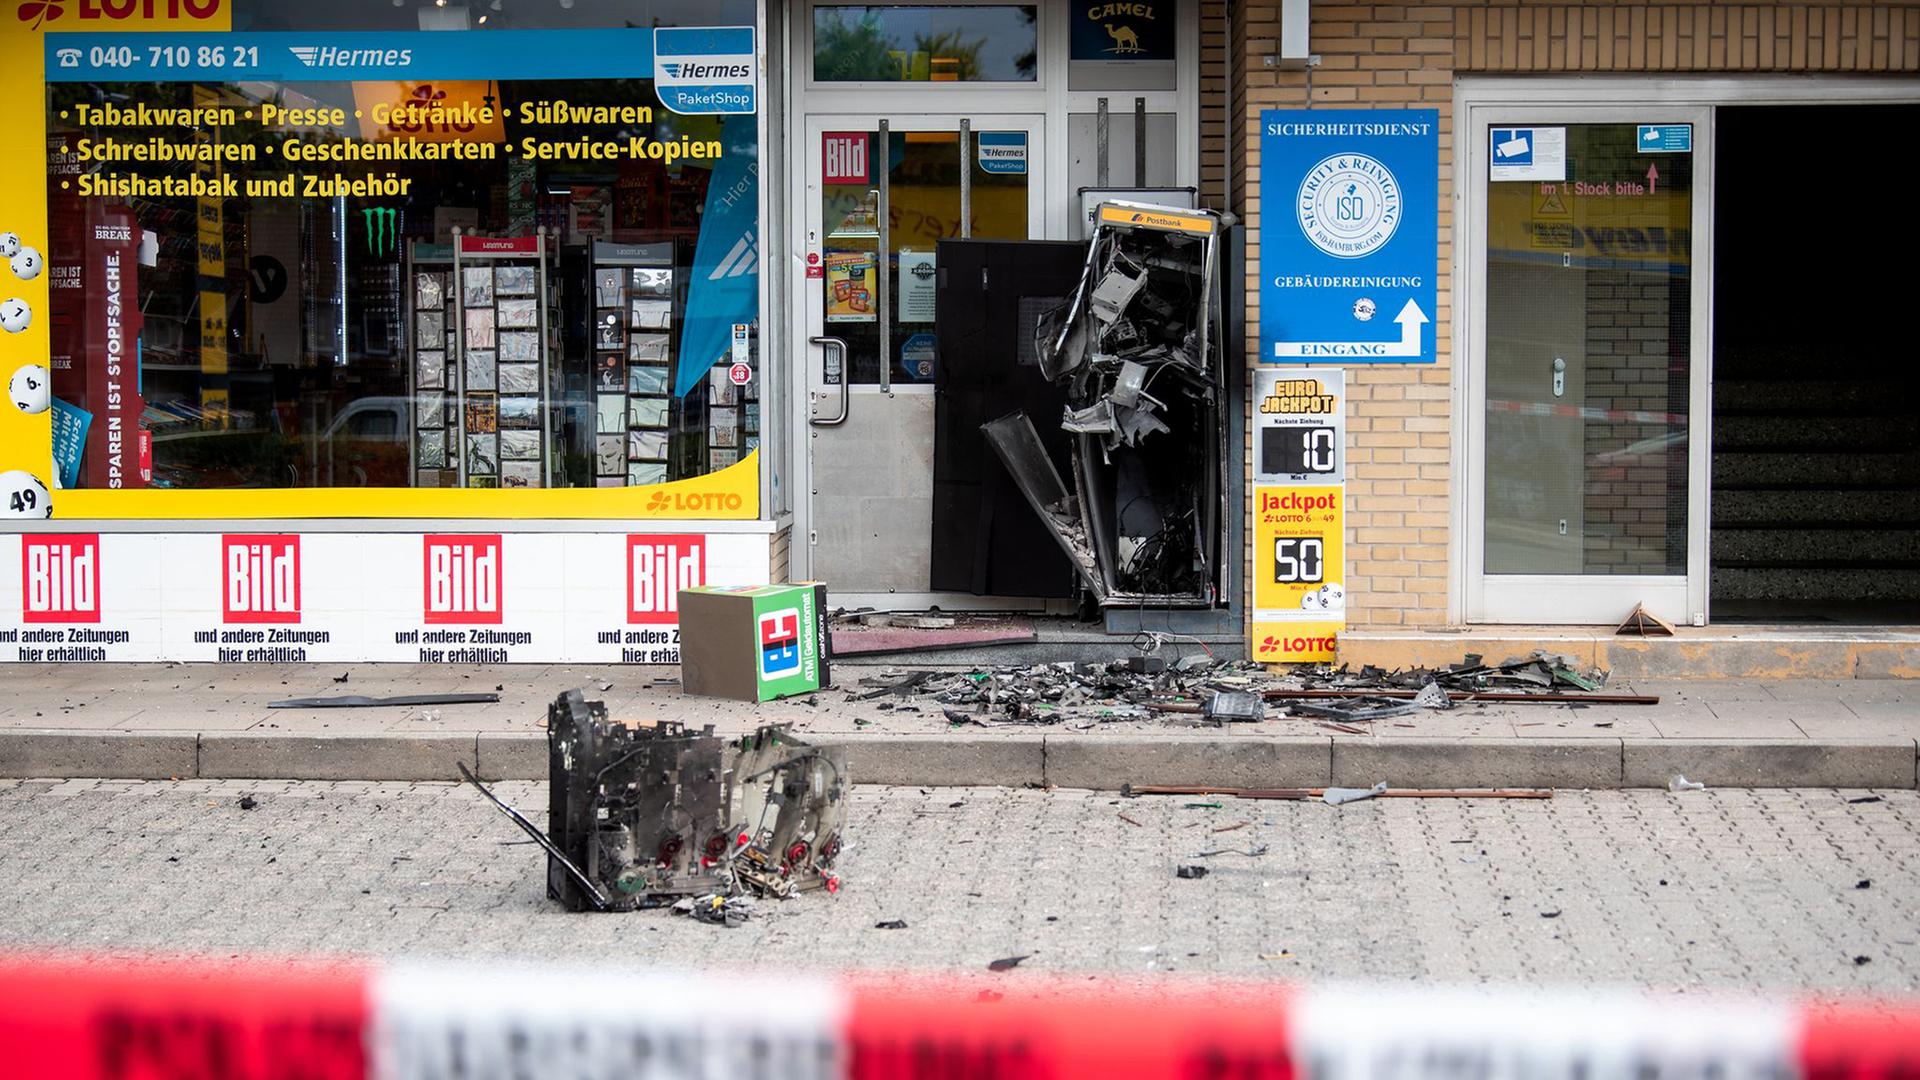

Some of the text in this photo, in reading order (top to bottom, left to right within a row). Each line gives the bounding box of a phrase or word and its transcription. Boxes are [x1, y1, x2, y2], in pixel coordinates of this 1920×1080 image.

[1088, 2, 1155, 20] CAMEL
[90, 46, 259, 67] 040- 710 86 21
[319, 46, 412, 66] Hermes
[681, 63, 750, 79] Hermes
[677, 92, 750, 106] PaketShop
[75, 100, 653, 126] Tabakwaren Presse Getränke Süßwaren
[1267, 123, 1431, 136] SICHERHEITSDIENST
[77, 137, 256, 162] Schreibwaren
[282, 137, 496, 161] Geschenkkarten
[522, 135, 722, 164] Service-Kopien
[826, 138, 865, 177] Bild
[991, 149, 1024, 157] Hermes
[988, 162, 1024, 170] PaketShop
[78, 172, 412, 198] Shishatabak und Zubehör
[722, 175, 751, 208] Hier
[1302, 158, 1396, 229] SECURITY & REINIGUNG
[1540, 182, 1556, 196] im
[1575, 182, 1610, 196] Stock
[1616, 182, 1644, 196] bitte
[1336, 196, 1364, 220] ISD
[1145, 216, 1182, 227] Postbank
[95, 230, 131, 240] BREAK
[1315, 230, 1383, 252] ISD-HAMBURG.COM
[26, 257, 33, 268] 3
[69, 266, 81, 278] IST
[1275, 274, 1422, 288] GEBÄUDEREINIGUNG
[15, 307, 23, 317] 7
[1300, 344, 1386, 355] EINGANG
[106, 250, 122, 489] SPAREN IST STOPFSACHE.
[1276, 380, 1318, 397] EURO
[1260, 395, 1334, 413] JACKPOT
[1303, 429, 1335, 471] 10
[9, 488, 37, 513] 49
[676, 493, 743, 511] LOTTO
[1262, 492, 1336, 513] Jackpot
[1275, 514, 1335, 523] LOTTO 6 49
[1275, 539, 1323, 582] 50
[28, 544, 95, 612] Bild
[228, 544, 296, 612] Bild
[429, 545, 497, 612] Bild
[633, 545, 700, 612] Bild
[0, 628, 129, 645] nd andere Zeitungen
[194, 628, 330, 645] und andere Zeitungen
[395, 629, 532, 646] und andere Zeitungen
[598, 629, 621, 644] und
[625, 629, 669, 644] andere
[1283, 637, 1336, 653] LOTTO
[19, 646, 106, 661] hier erhältlich
[218, 647, 306, 662] hier erhältlich
[419, 648, 508, 663] hier erhältlich
[622, 648, 647, 663] hier
[804, 660, 815, 682] ATM
